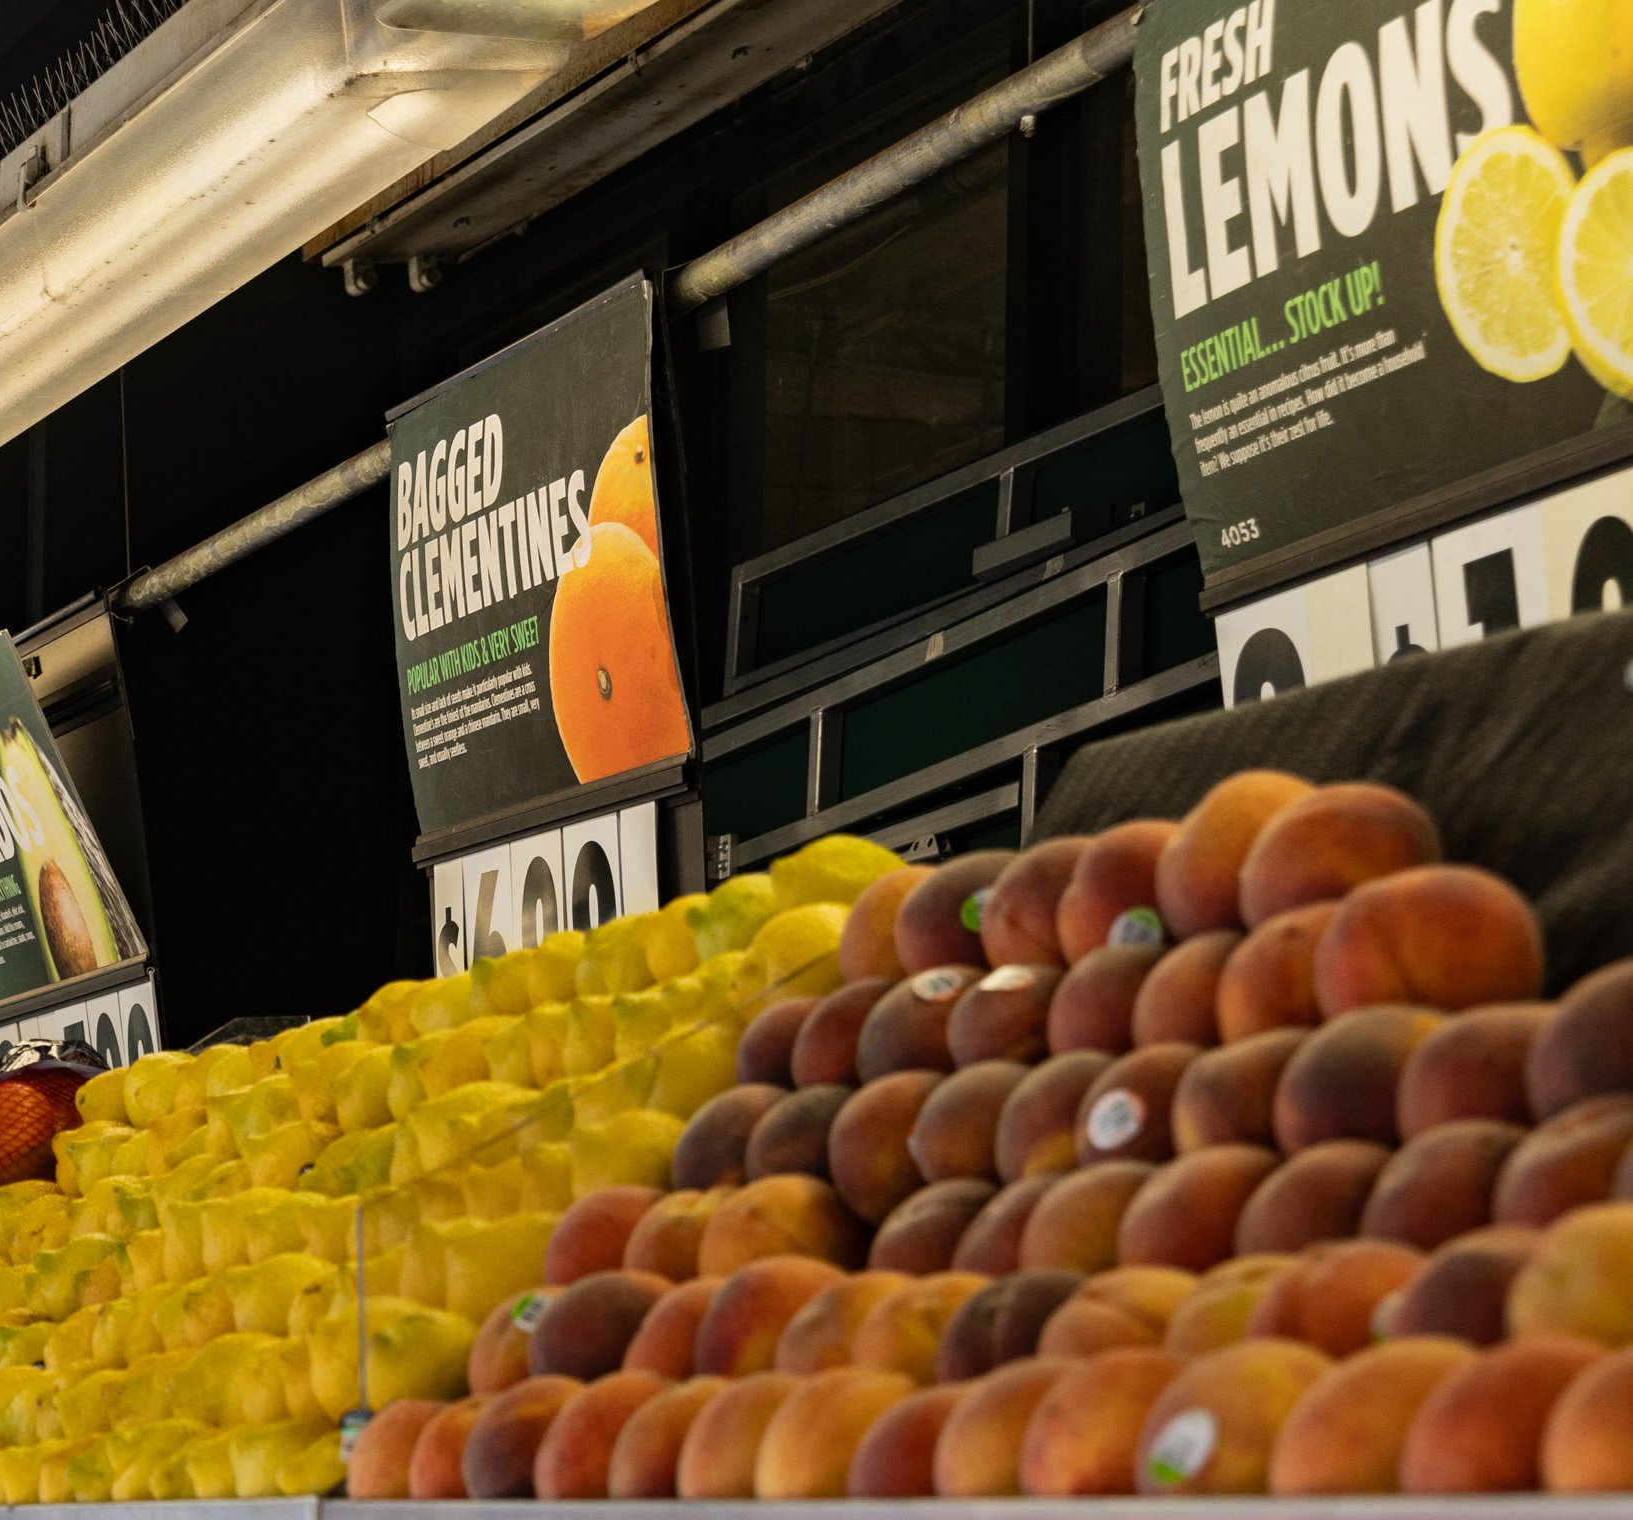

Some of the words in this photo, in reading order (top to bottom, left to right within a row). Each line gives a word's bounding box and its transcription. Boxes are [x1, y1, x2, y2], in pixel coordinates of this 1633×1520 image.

[1160, 0, 1274, 132] FRESH
[1160, 0, 1513, 320] LEMONS
[1285, 277, 1348, 344] STOCK
[1345, 261, 1386, 316] UP!
[397, 413, 503, 552] BAGGED
[1221, 517, 1260, 549] 4053
[398, 469, 591, 642] CLEMENTINES
[406, 657, 441, 696] POPULAR
[438, 648, 462, 682] WITH
[460, 640, 481, 674] KIDS
[480, 637, 490, 665] &
[487, 627, 512, 662] VERY
[510, 615, 540, 653] SWEET
